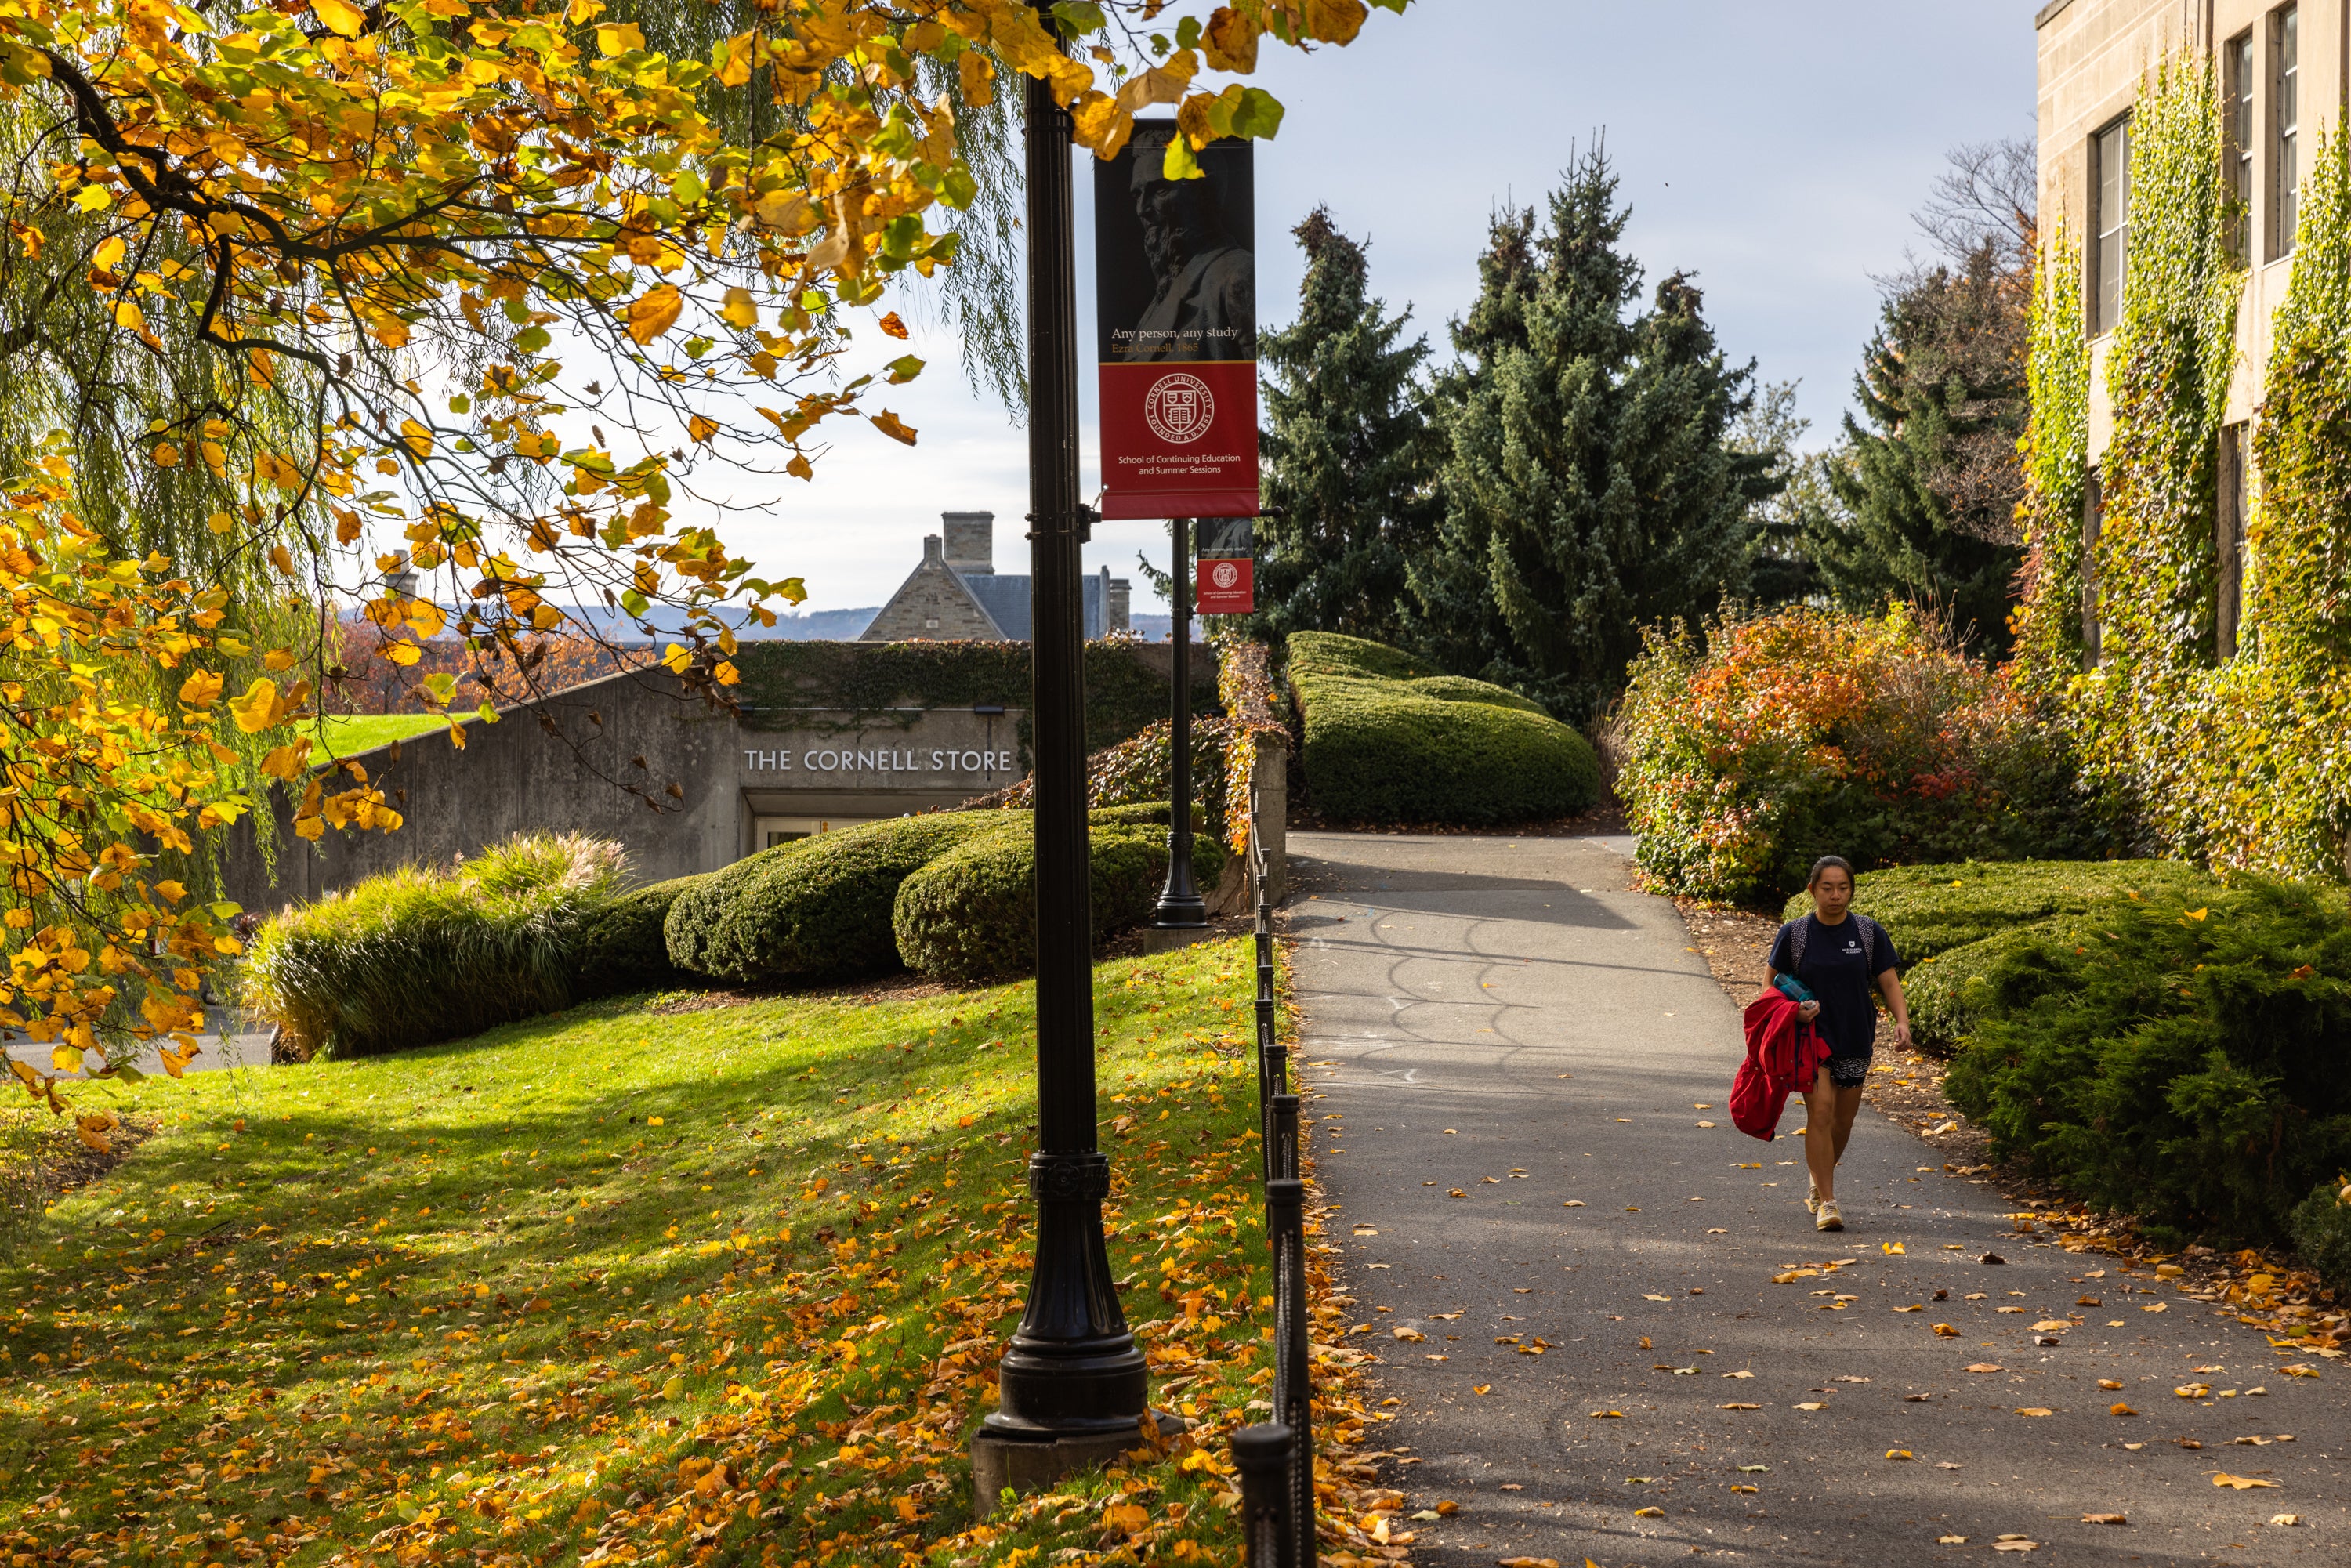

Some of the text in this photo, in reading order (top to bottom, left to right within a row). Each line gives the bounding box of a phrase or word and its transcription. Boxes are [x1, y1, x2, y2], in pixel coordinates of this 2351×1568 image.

[1111, 326, 1238, 342] Any person, any study
[1112, 344, 1133, 353] Ezra
[1177, 343, 1198, 352] 1865
[1147, 375, 1212, 410] CORNELL UNIVERSITY
[1149, 413, 1211, 441] FOUNDED A.D. 1865
[1156, 455, 1200, 464] Continuing
[1201, 454, 1241, 462] Education
[744, 750, 1011, 771] THE CORNELL STORE
